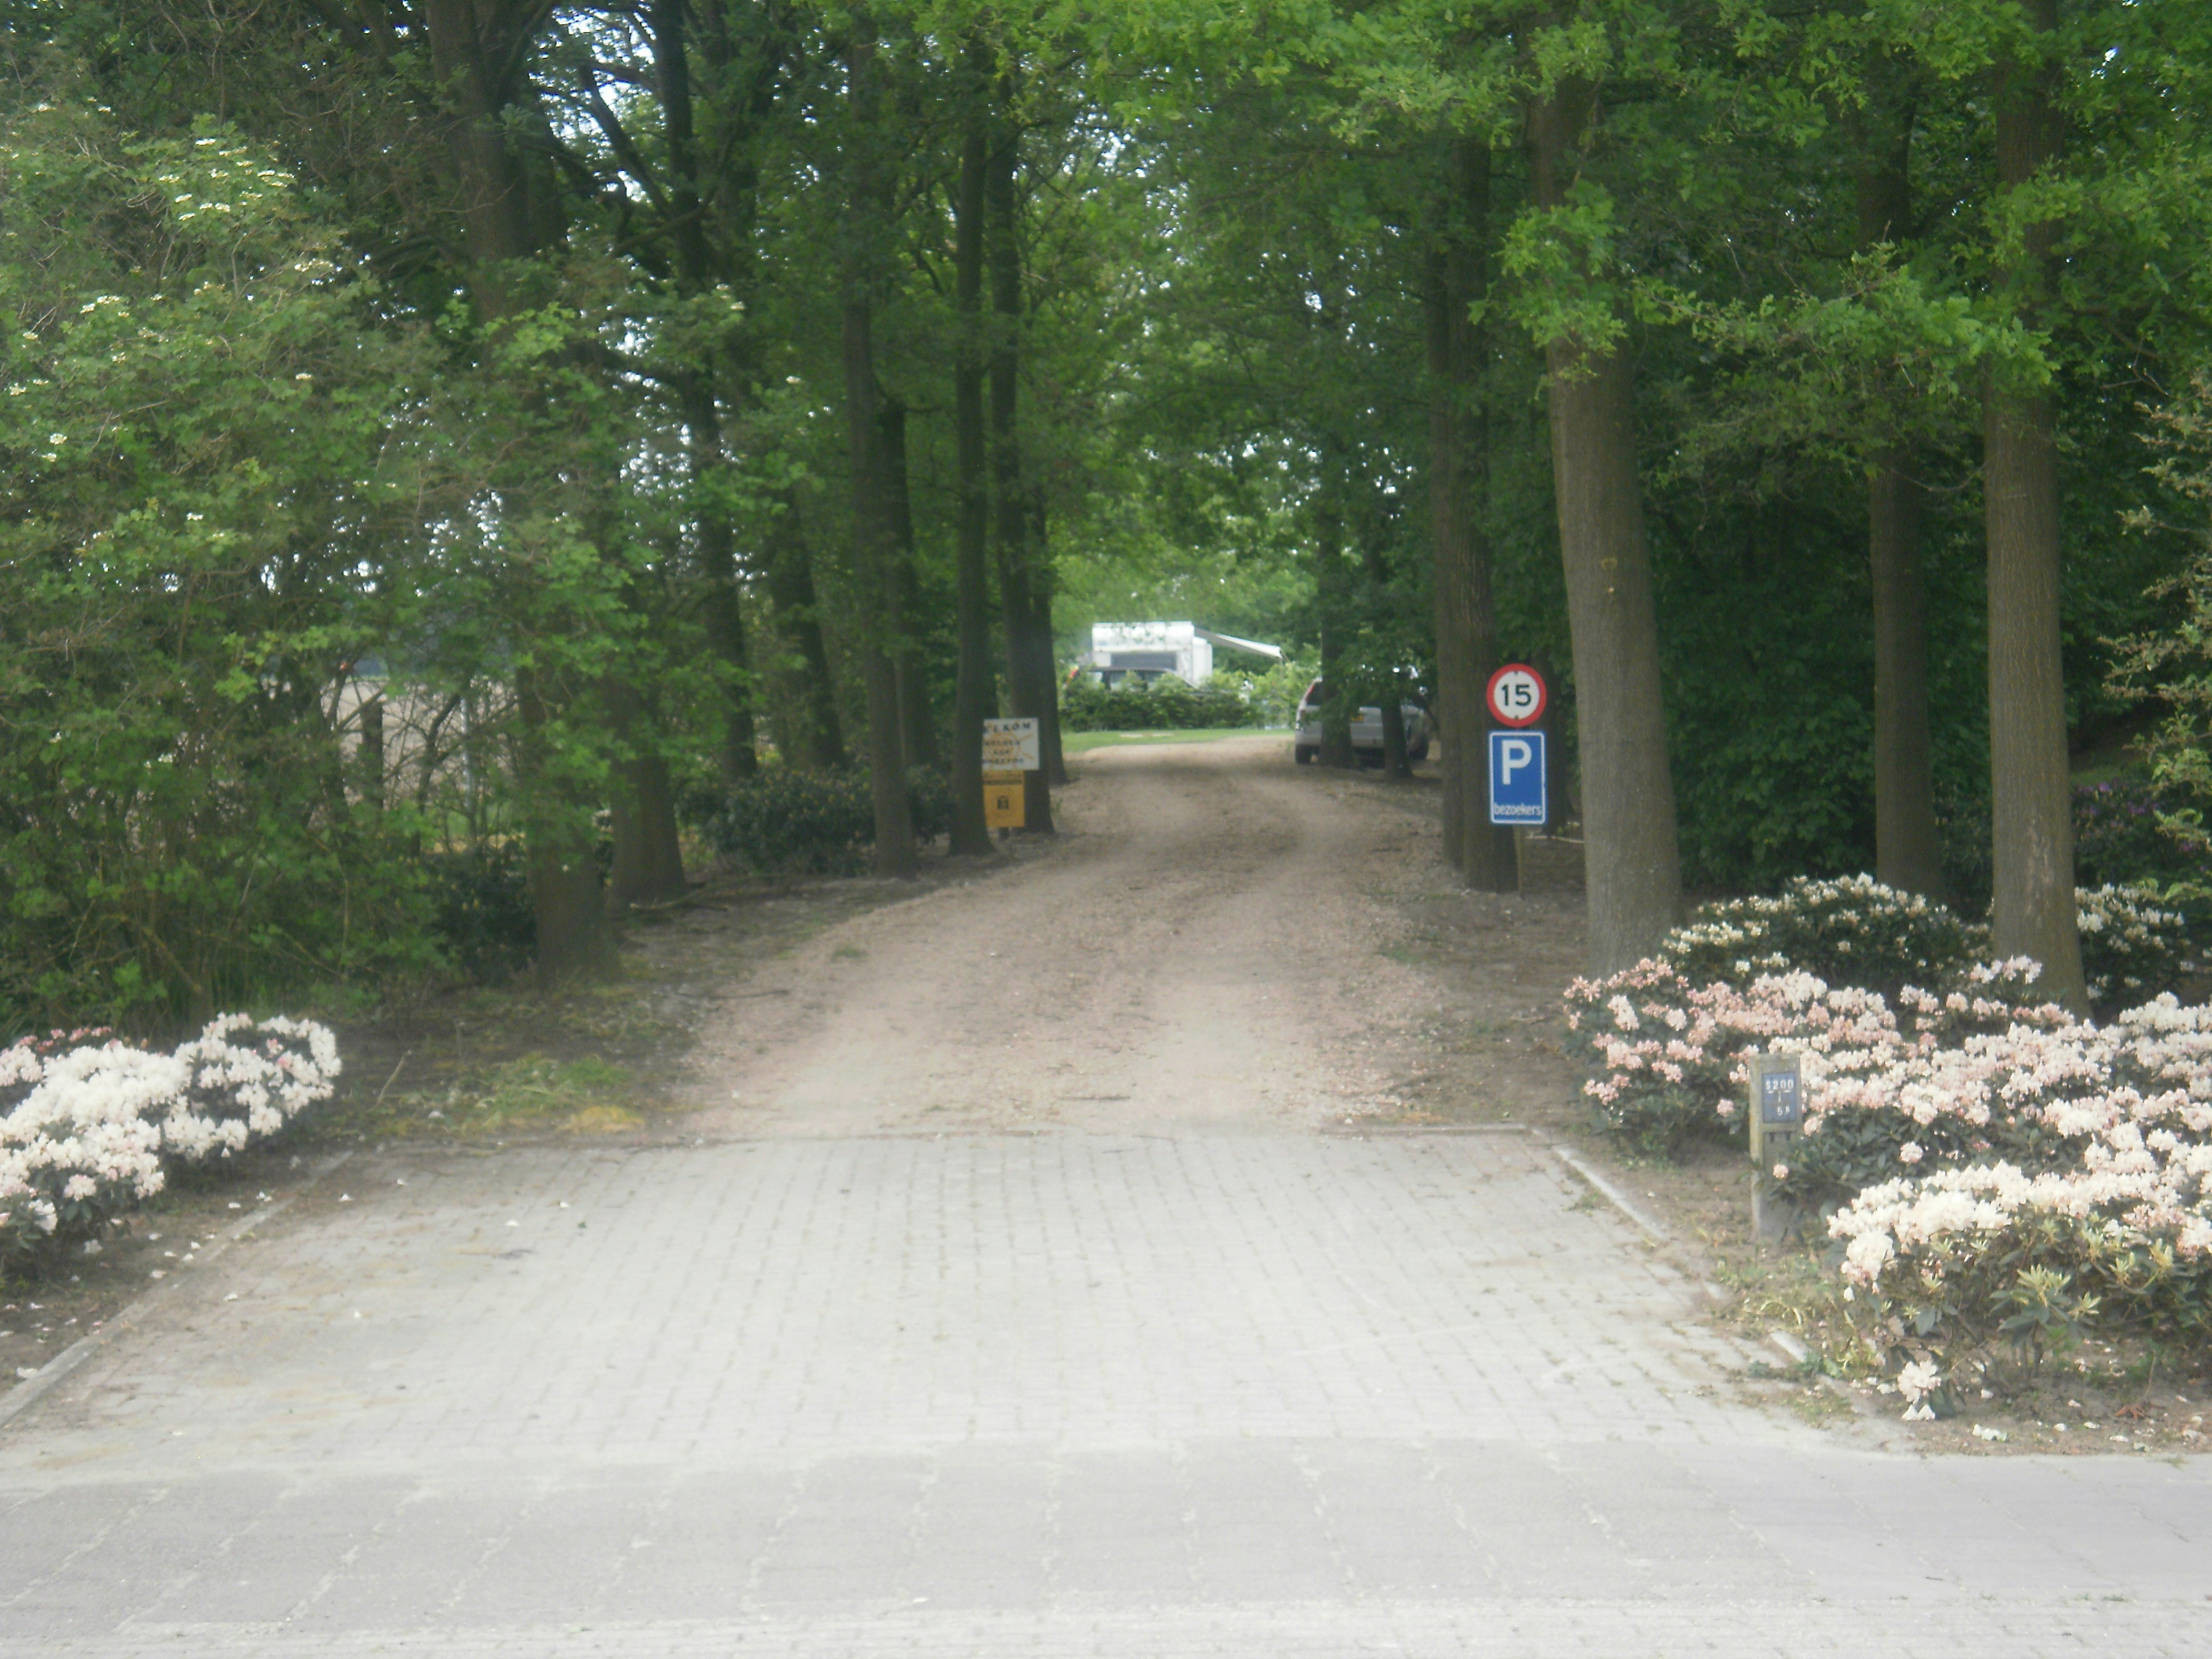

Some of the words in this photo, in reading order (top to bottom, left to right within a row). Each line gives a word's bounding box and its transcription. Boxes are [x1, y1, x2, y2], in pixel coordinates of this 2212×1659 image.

[1501, 684, 1531, 706] 15
[1502, 740, 1532, 785] P
[1495, 804, 1541, 816] bezoekers
